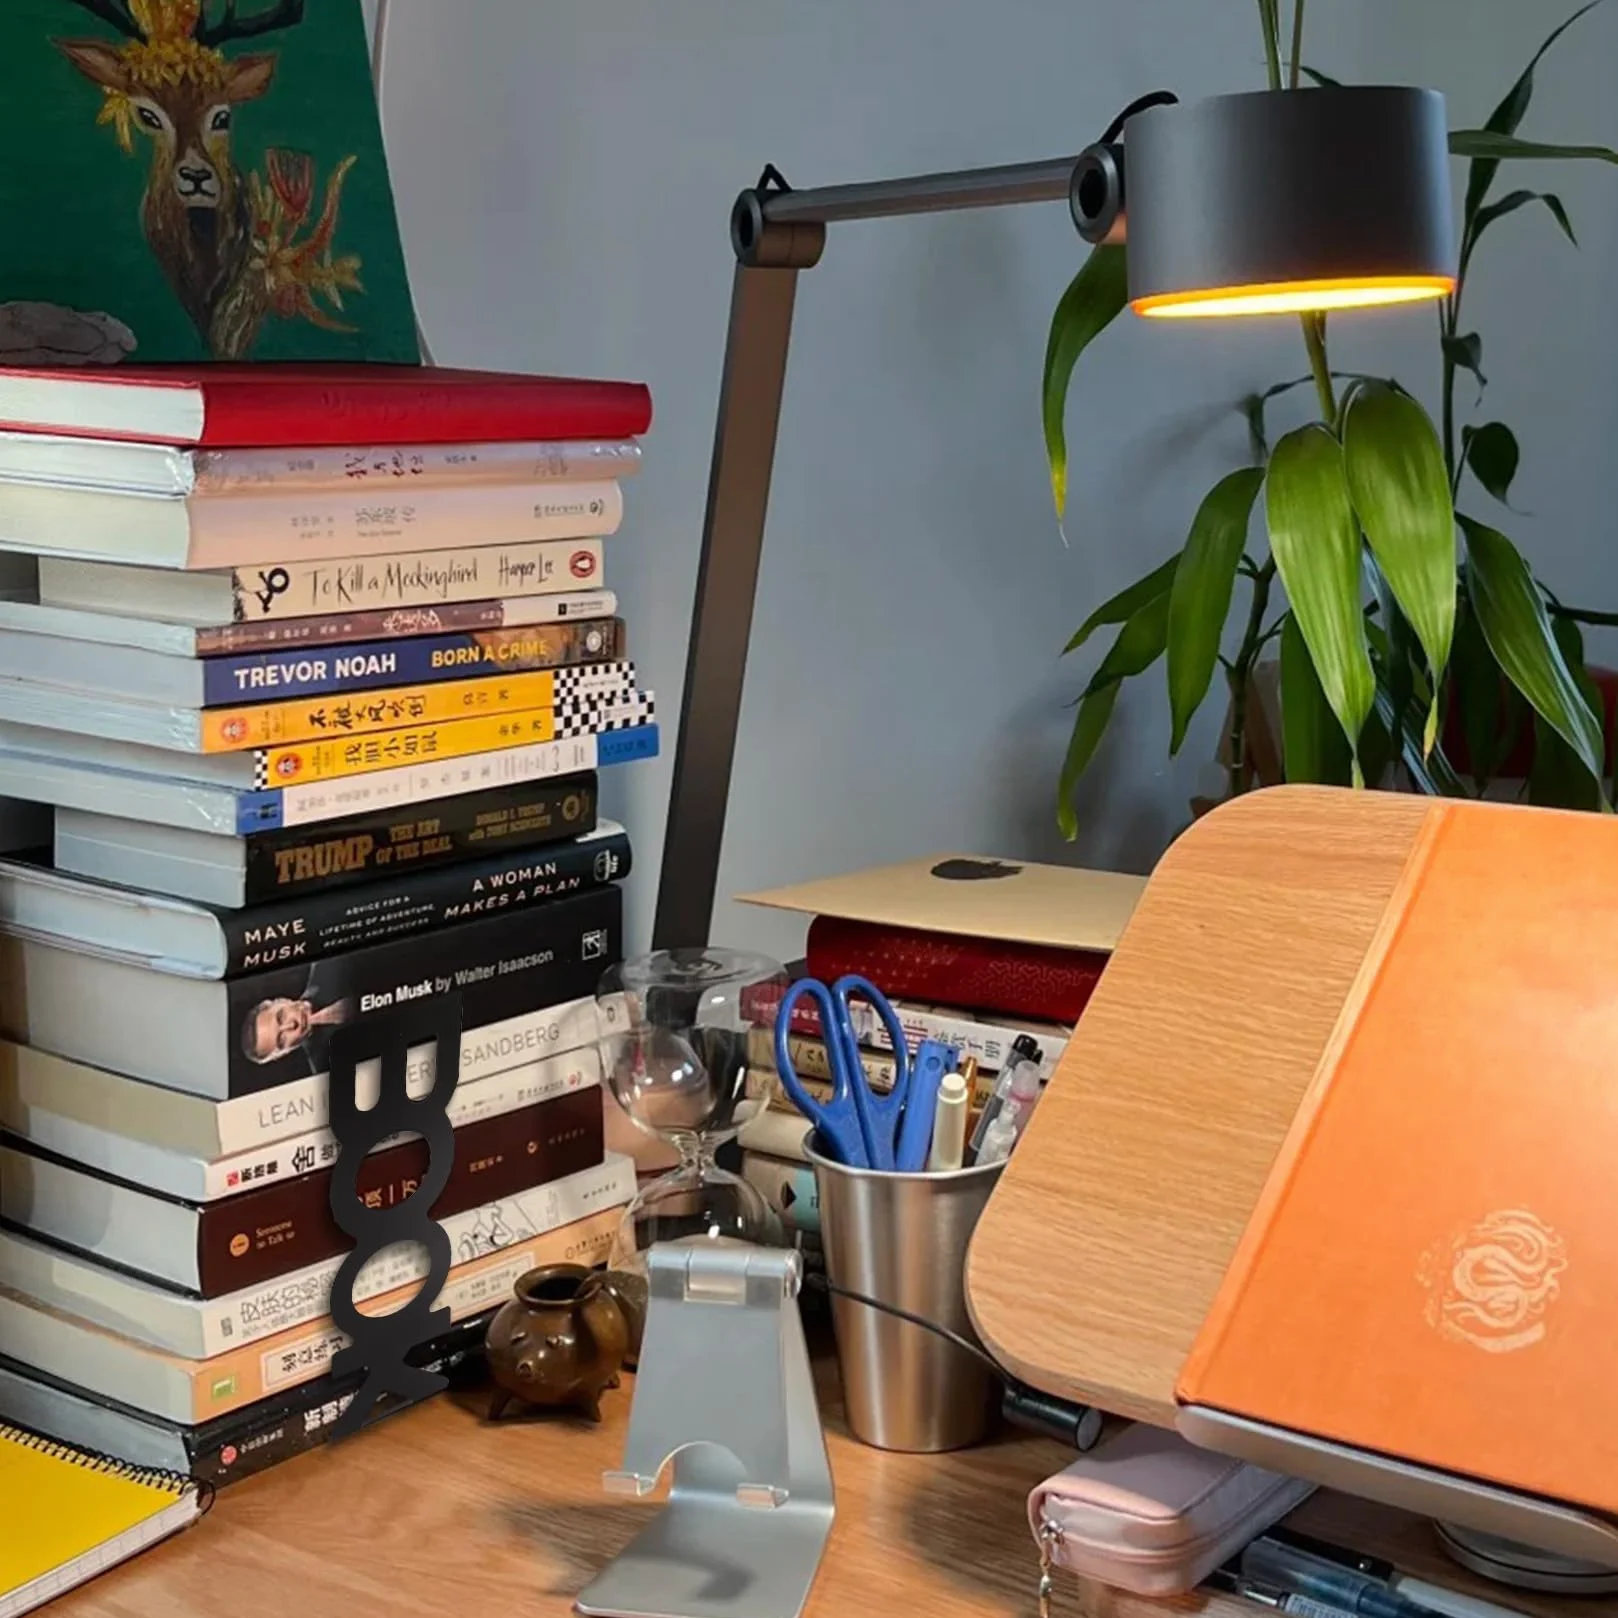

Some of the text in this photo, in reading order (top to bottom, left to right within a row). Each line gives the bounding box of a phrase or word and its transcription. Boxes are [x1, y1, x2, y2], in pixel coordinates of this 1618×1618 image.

[303, 557, 478, 606] To Kill a Mockingbird
[499, 552, 555, 587] Harper Lee
[431, 637, 548, 668] BORN A CRIME
[234, 653, 396, 690] TREVOR NOAH
[309, 694, 427, 730] 不被大风吹倒
[389, 819, 440, 843] THE ART
[275, 834, 373, 884] TRUMP
[396, 841, 419, 861] THE
[423, 836, 453, 856] DEAL
[472, 862, 557, 892] A WOMAN
[346, 902, 379, 916] ADVICE
[383, 897, 401, 907] FOR
[444, 877, 580, 919] MAKES A PLAN
[244, 918, 306, 944] MAYE
[319, 904, 434, 937] LIFETIME OF ADVENTURE
[243, 942, 306, 968] MUSK
[360, 948, 554, 1012] Elon Musk by Walter Isaacson
[461, 1023, 560, 1067] SANDBERG
[258, 1096, 314, 1128] LEAN
